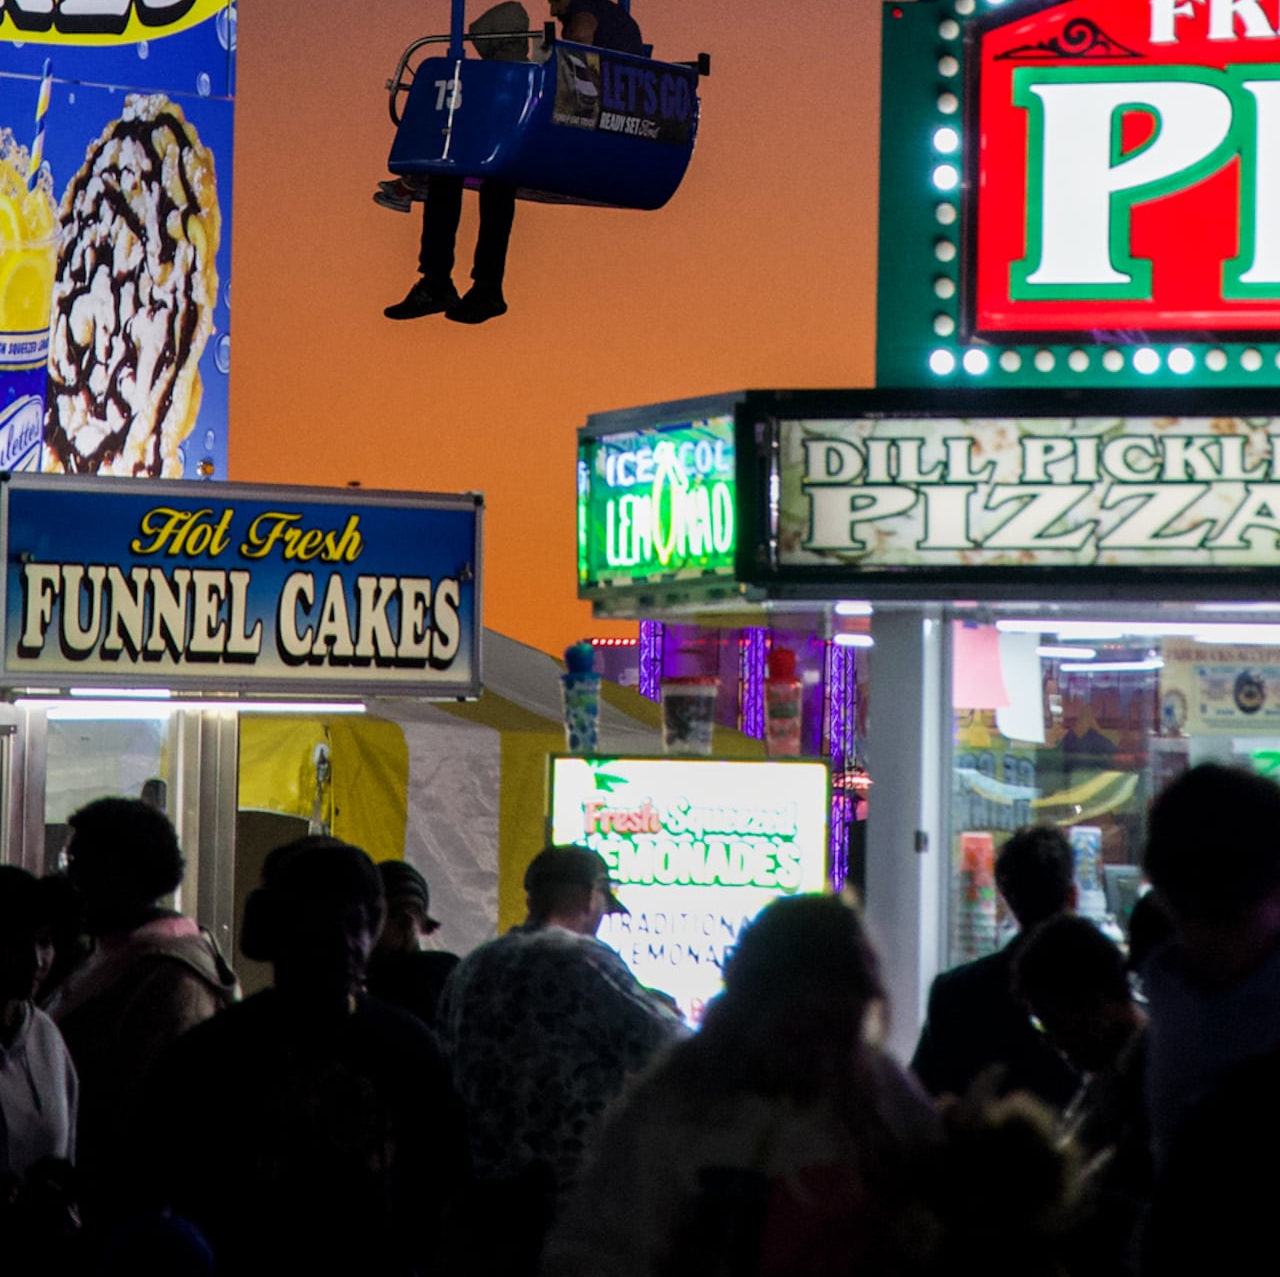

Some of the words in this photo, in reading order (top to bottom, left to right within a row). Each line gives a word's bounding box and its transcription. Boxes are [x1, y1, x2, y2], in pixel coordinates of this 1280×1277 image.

[435, 79, 463, 111] 73
[601, 61, 657, 116] LET'S
[660, 72, 691, 122] GO
[599, 111, 625, 133] READY
[625, 117, 641, 135] SET
[606, 447, 654, 488] ICE
[801, 435, 995, 485] DILL
[131, 507, 233, 557] Hot
[240, 511, 364, 563] Fresh
[18, 562, 262, 664] FUNNEL
[277, 570, 462, 670] CAKES
[584, 798, 662, 835] Fresh
[592, 838, 802, 893] EMONADES
